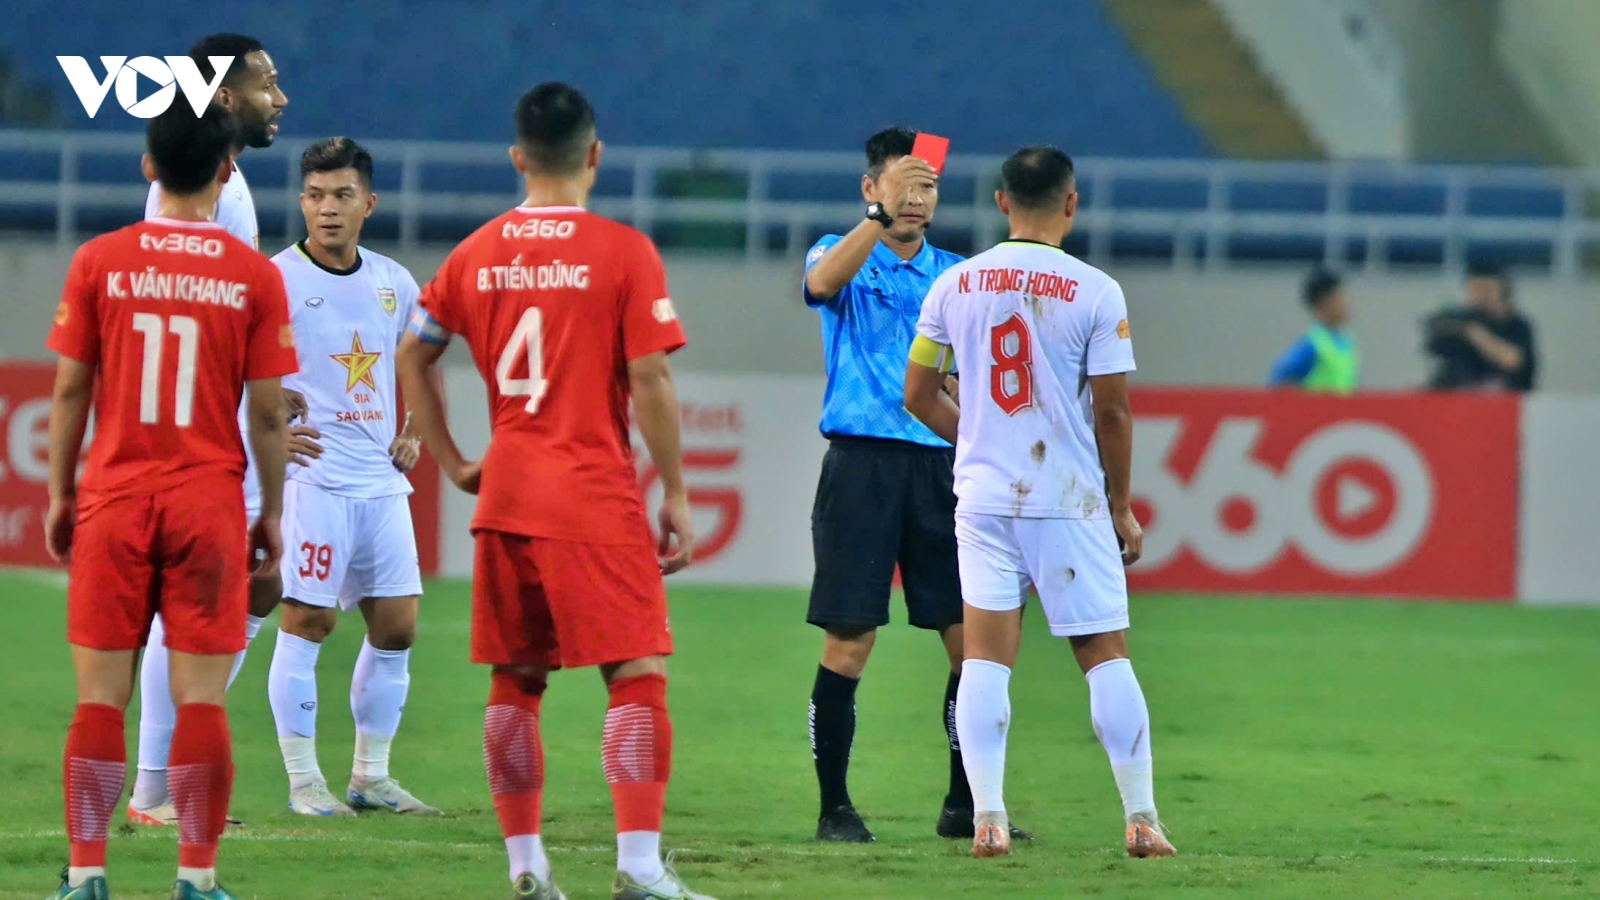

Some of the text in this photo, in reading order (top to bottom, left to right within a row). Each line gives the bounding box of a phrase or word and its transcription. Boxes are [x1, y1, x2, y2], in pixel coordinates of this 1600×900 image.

[139, 232, 224, 258] tv360
[501, 218, 577, 239] tv360
[107, 265, 247, 310] K. VĂN KHANG
[537, 259, 590, 290] DŨNG
[958, 271, 971, 294] N.
[1025, 270, 1079, 303] HOÀNG
[132, 312, 199, 428] 11
[495, 306, 548, 415] 4
[990, 311, 1033, 417] 8
[354, 393, 371, 404] BIA
[298, 540, 333, 581] 39
